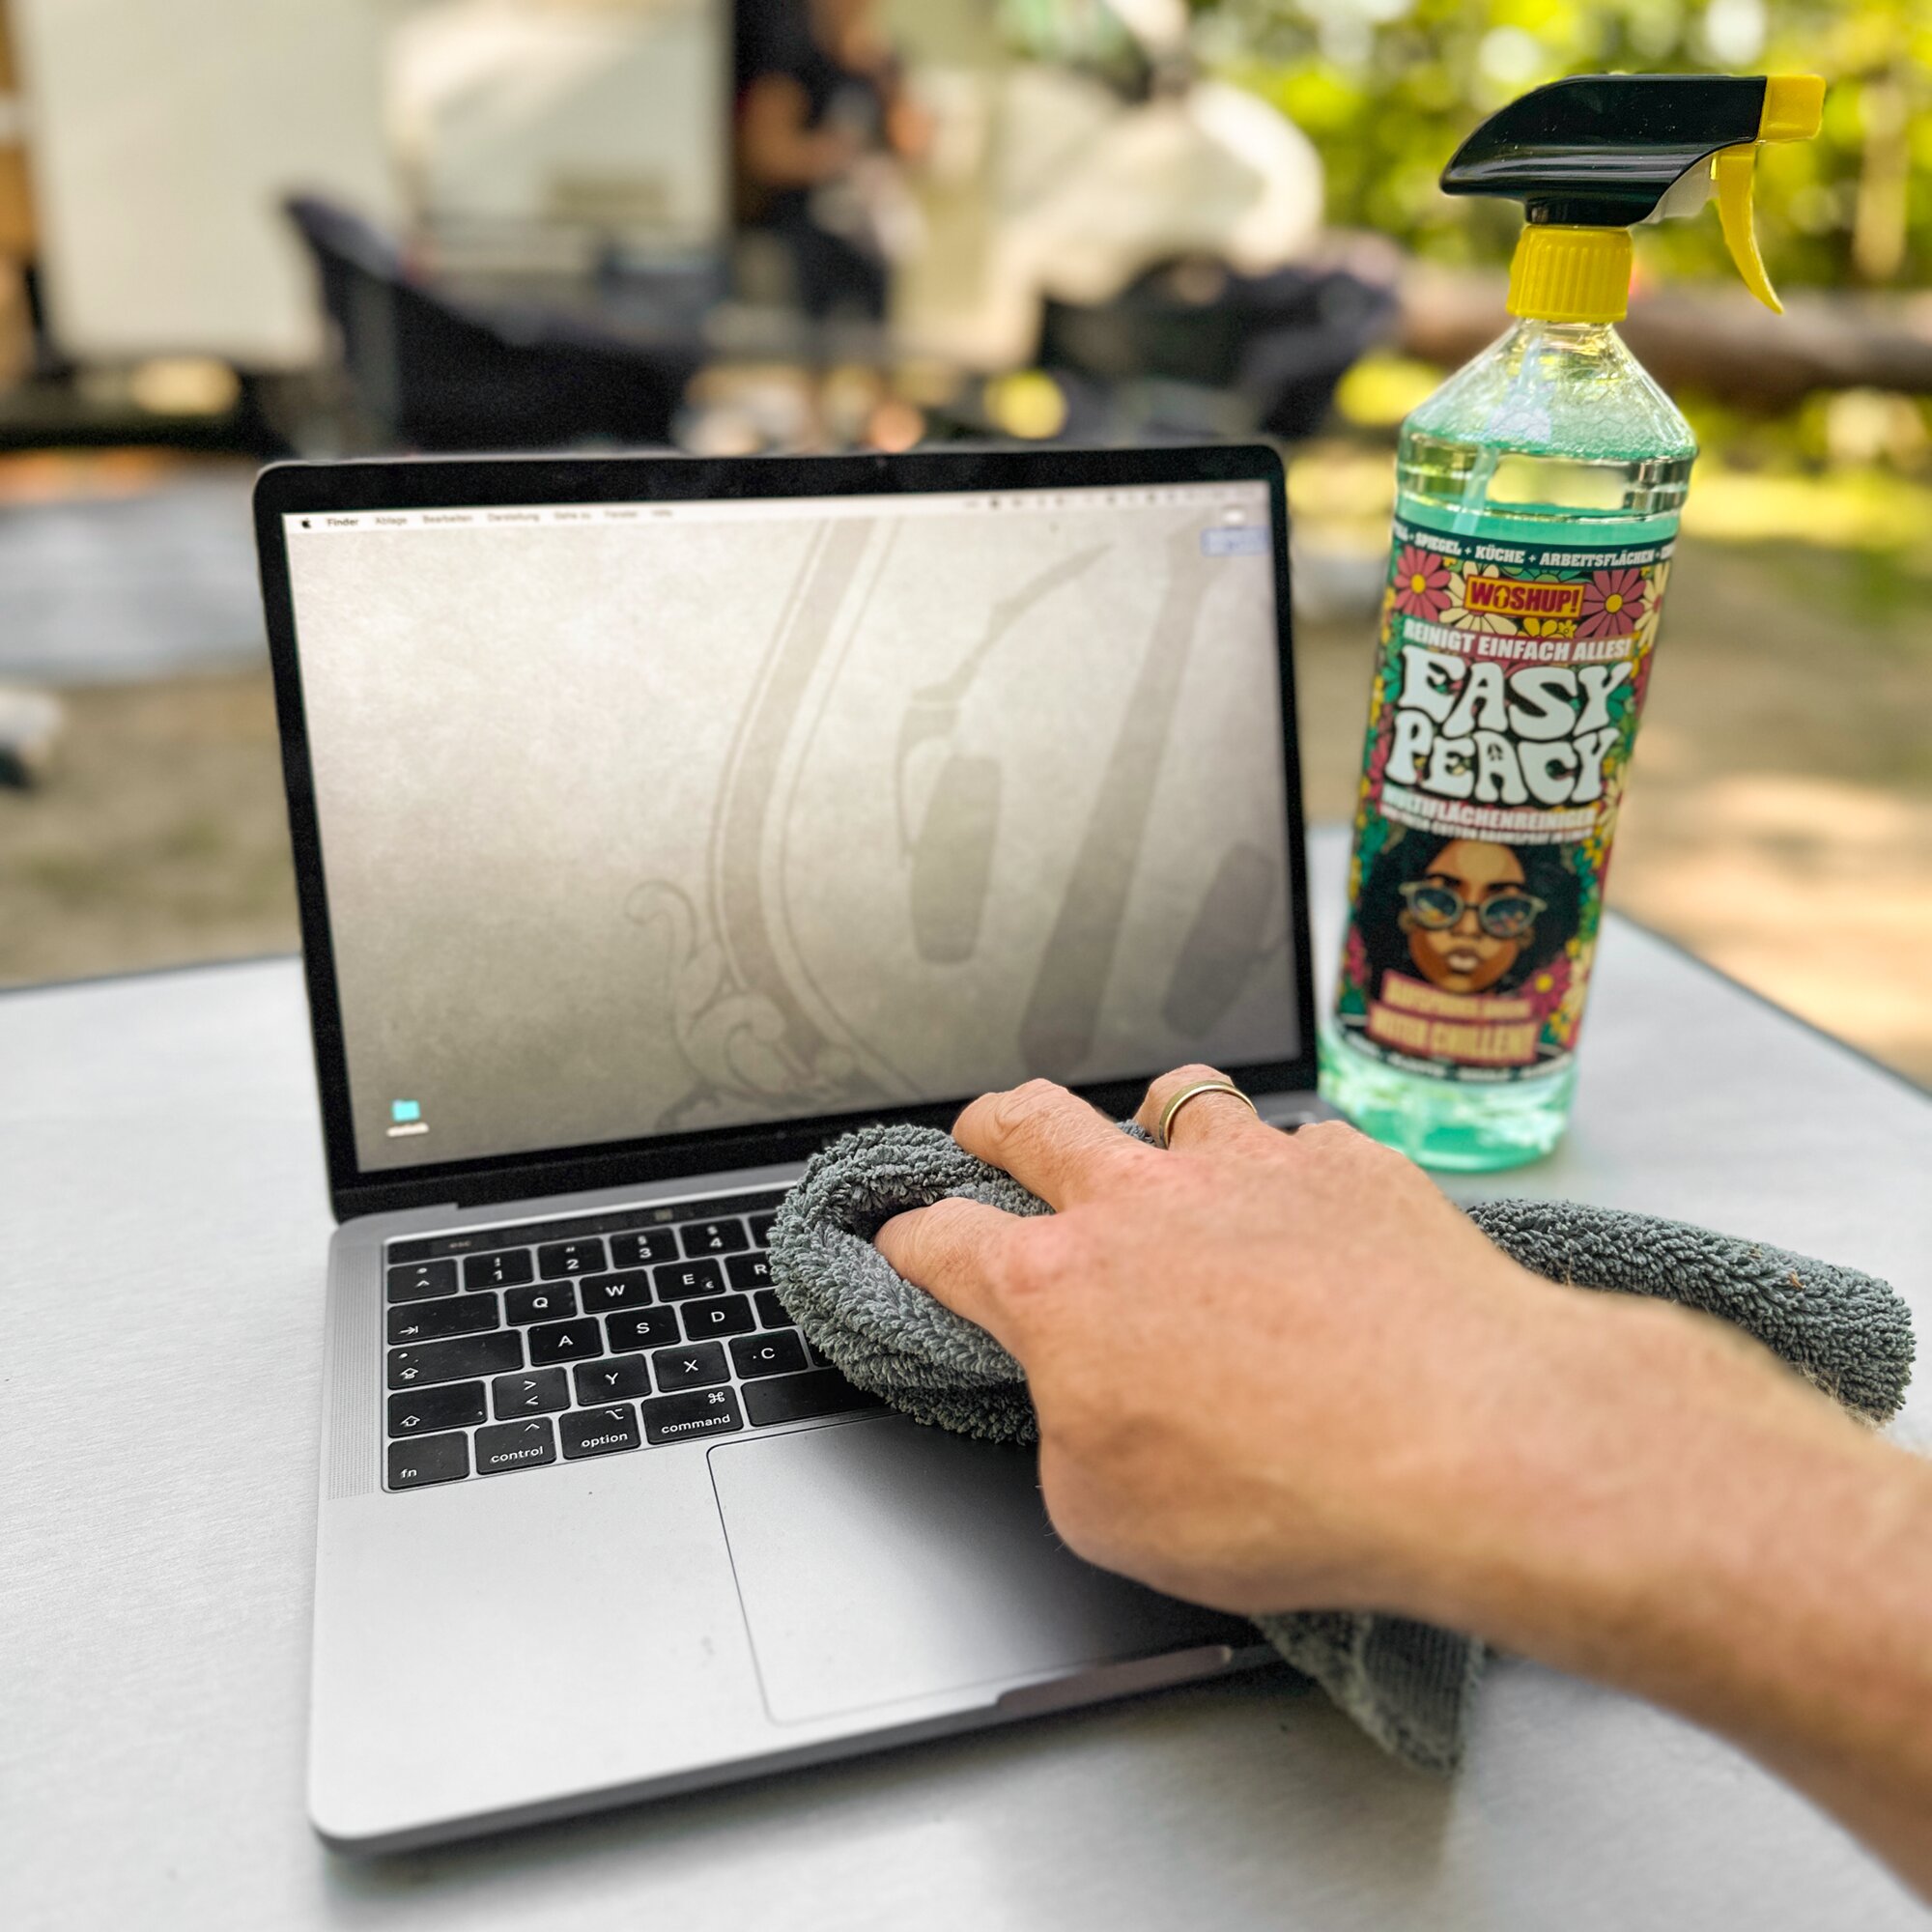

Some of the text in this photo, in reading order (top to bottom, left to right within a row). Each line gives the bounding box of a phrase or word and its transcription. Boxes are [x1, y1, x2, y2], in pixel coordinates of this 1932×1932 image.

[327, 518, 359, 527] Finder
[375, 516, 408, 526] Ablage
[1414, 530, 1463, 556] SPIEGEL
[1474, 543, 1526, 565] KÜCHE
[1539, 548, 1656, 568] ARBEITSFLÄCHEN
[1403, 618, 1634, 663] REINIGT EINFACH ALLES!
[1398, 644, 1634, 740] EASY
[1384, 709, 1620, 805] PEACY
[1381, 783, 1597, 832] MULTIFLÄCHENREINIGER
[709, 1237, 723, 1248] 4
[639, 1247, 652, 1260] 3
[566, 1258, 580, 1271] 2
[753, 1264, 769, 1276] R
[494, 1269, 503, 1282] 1
[682, 1273, 696, 1287] E
[605, 1284, 626, 1297] W
[532, 1296, 549, 1310] Q
[711, 1310, 725, 1323] D
[636, 1321, 650, 1335] S
[557, 1334, 574, 1349] A
[761, 1347, 776, 1360] C
[683, 1359, 699, 1374] X
[604, 1371, 619, 1386] Y
[660, 1413, 731, 1435] command
[582, 1431, 628, 1450] option
[490, 1446, 544, 1464] control
[399, 1467, 417, 1479] fn
